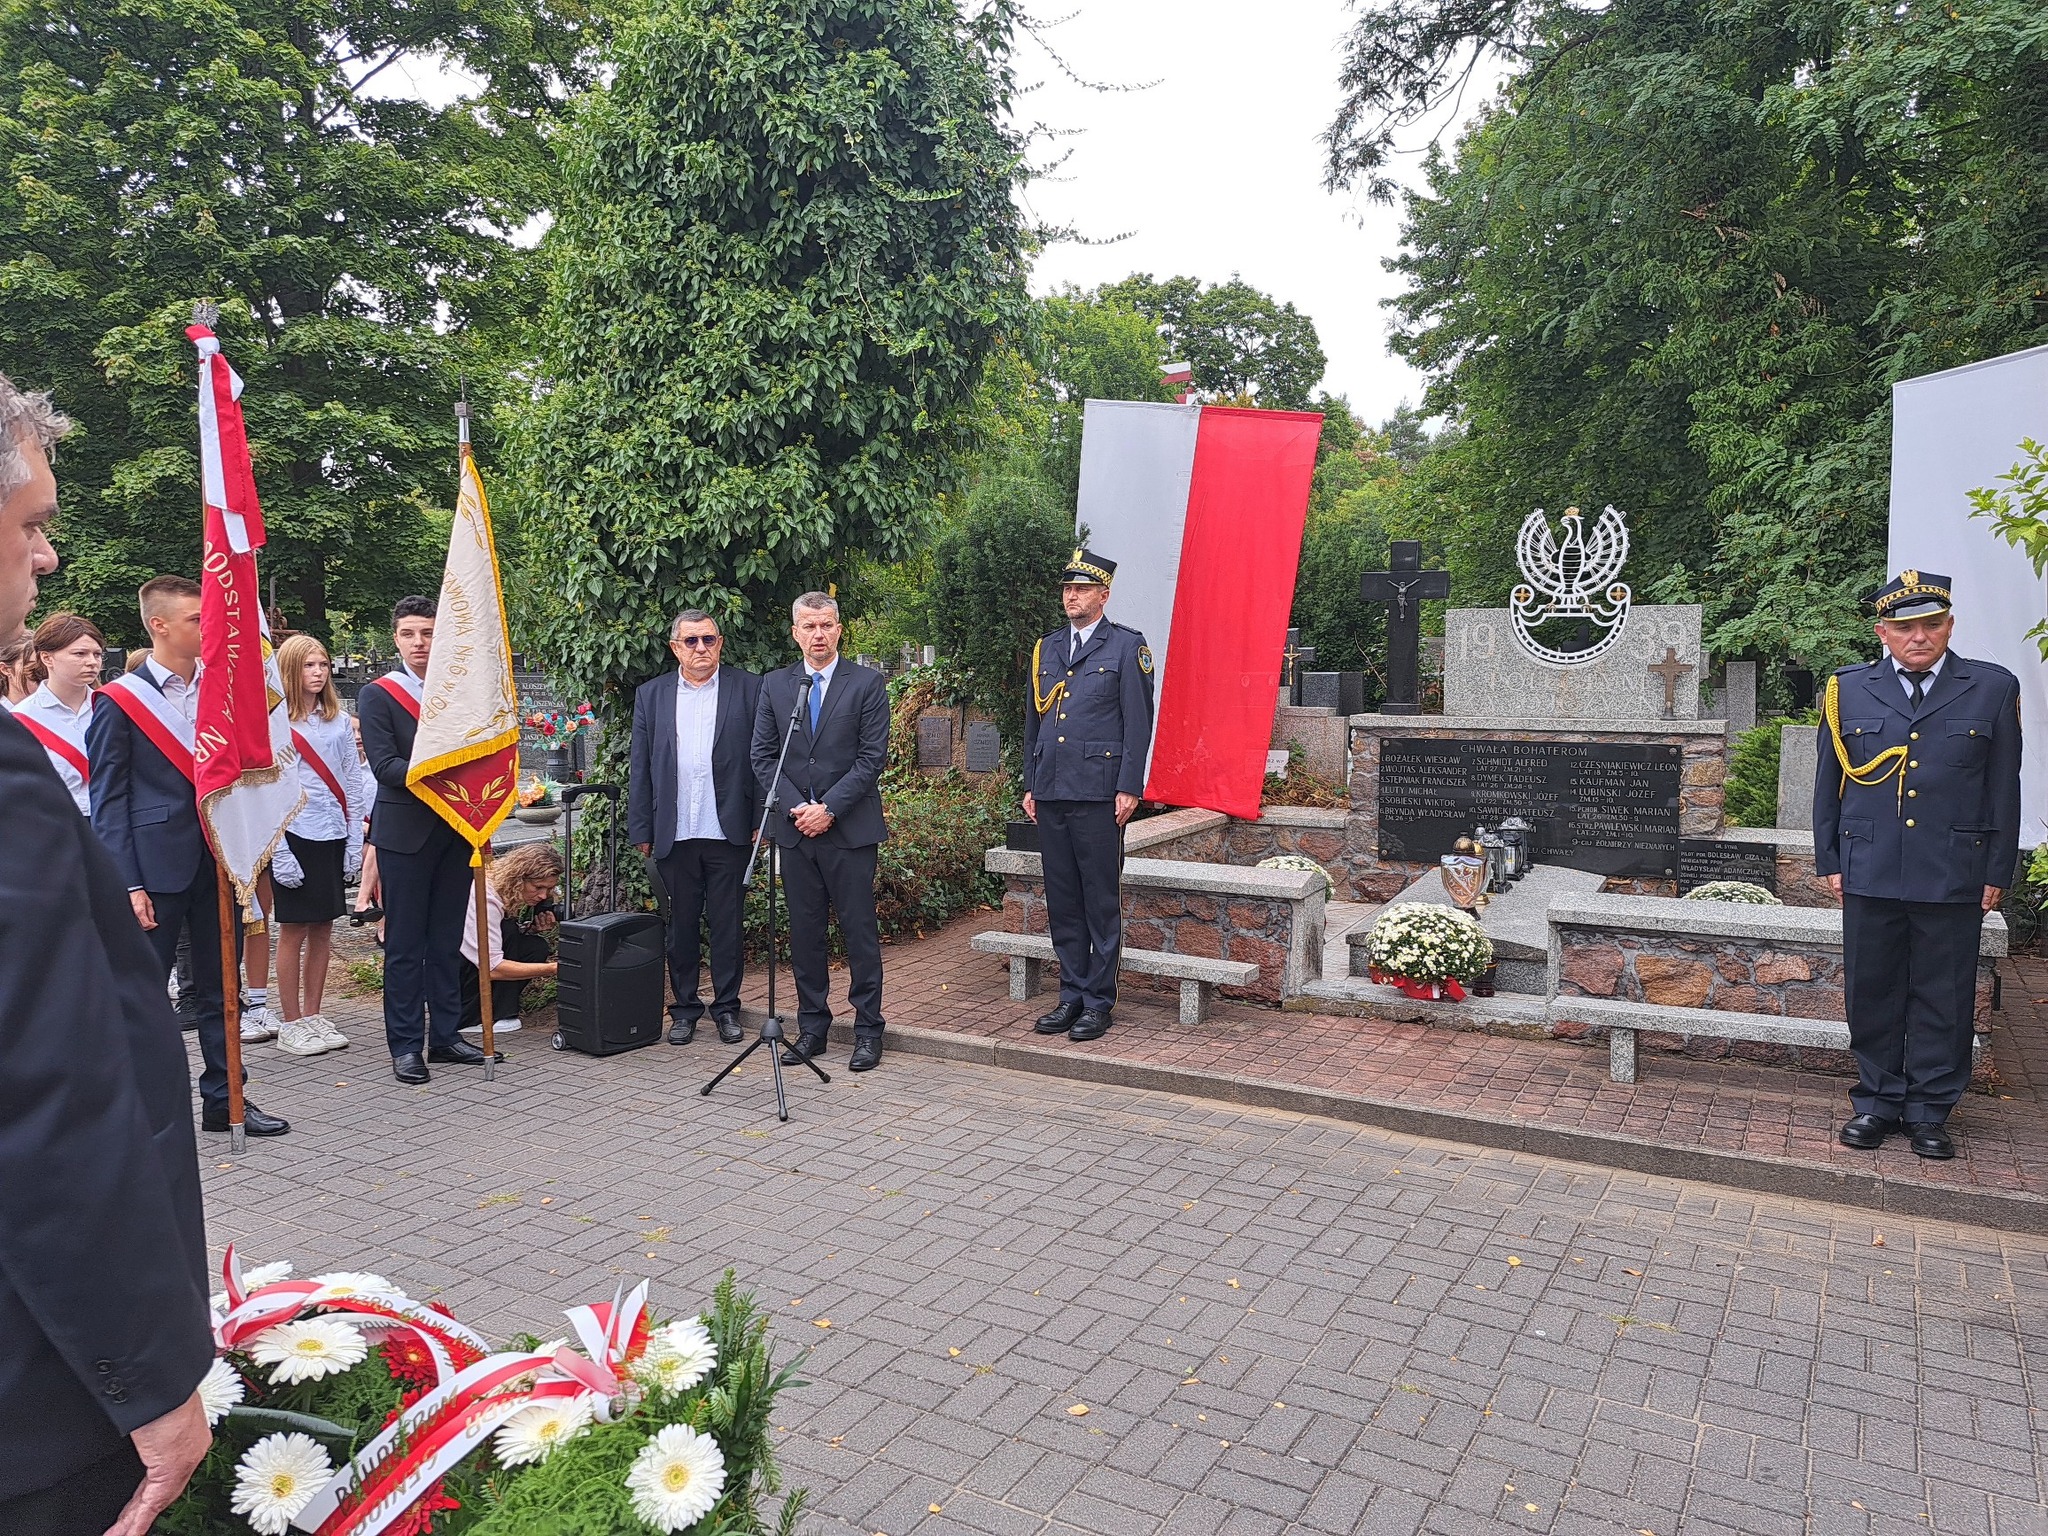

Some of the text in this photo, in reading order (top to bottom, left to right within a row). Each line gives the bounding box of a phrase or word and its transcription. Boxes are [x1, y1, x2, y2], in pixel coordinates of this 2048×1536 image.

[449, 665, 468, 677] 6
[196, 724, 229, 764] NR
[1460, 744, 1588, 756] CHWAŁA BOHATEROM
[1424, 755, 1461, 764] WIESŁAW
[1515, 758, 1548, 767] ALFRED
[1418, 766, 1468, 775] ALEKSANDER
[1654, 763, 1678, 771] LEON
[1422, 777, 1468, 787] FRANCISZEK
[1508, 775, 1548, 784] TADEUSZ
[1629, 779, 1649, 788] JAN
[1408, 787, 1439, 796] MICHAŁ
[1533, 791, 1560, 801] JÓZEF
[1625, 788, 1656, 799] JÓZEF
[1424, 798, 1456, 807] WIKTOR
[1417, 808, 1466, 818] WŁADYSŁAW
[1511, 808, 1555, 817] MATEUSZ
[1600, 805, 1630, 815] SIWEK
[1633, 807, 1671, 816] MARIAN
[1644, 824, 1677, 835] MARIAN
[1634, 841, 1675, 851] NIEZNANYCH
[1540, 848, 1575, 856] CHWAŁY
[1707, 851, 1742, 860] BOLESŁAW
[1744, 853, 1760, 861] GIZA
[1680, 864, 1721, 873] WŁADYSŁAW
[1723, 868, 1760, 876] ADAMCZUK
